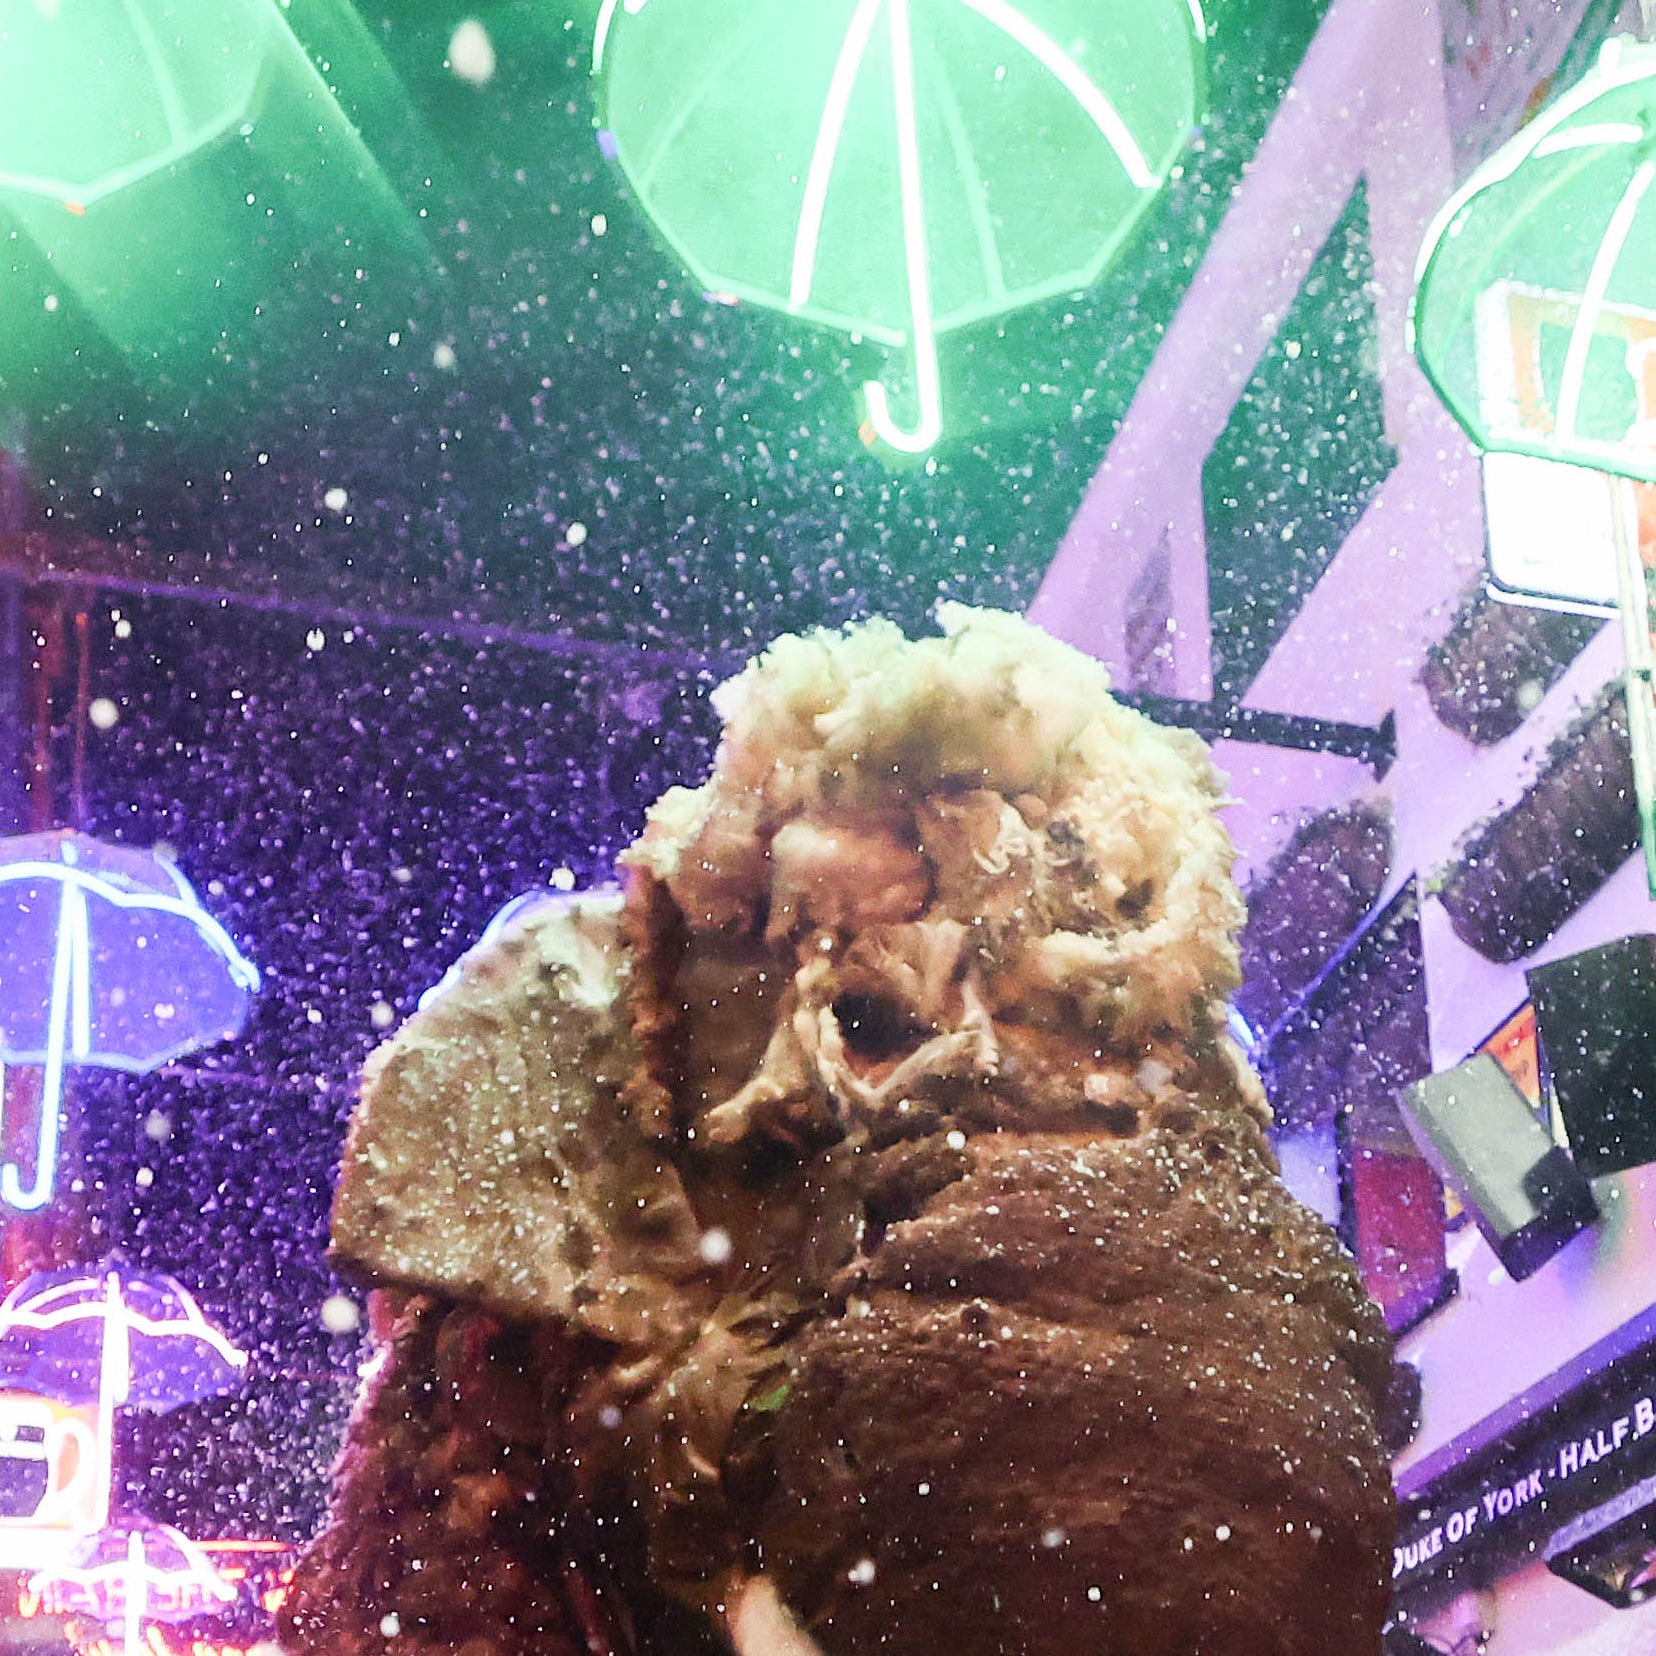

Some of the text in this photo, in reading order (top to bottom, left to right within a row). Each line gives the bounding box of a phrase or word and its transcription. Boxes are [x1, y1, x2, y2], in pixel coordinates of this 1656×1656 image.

[1447, 1506, 1479, 1542] OF
[1482, 1468, 1544, 1522] YORK
[1559, 1416, 1630, 1479] HALF
